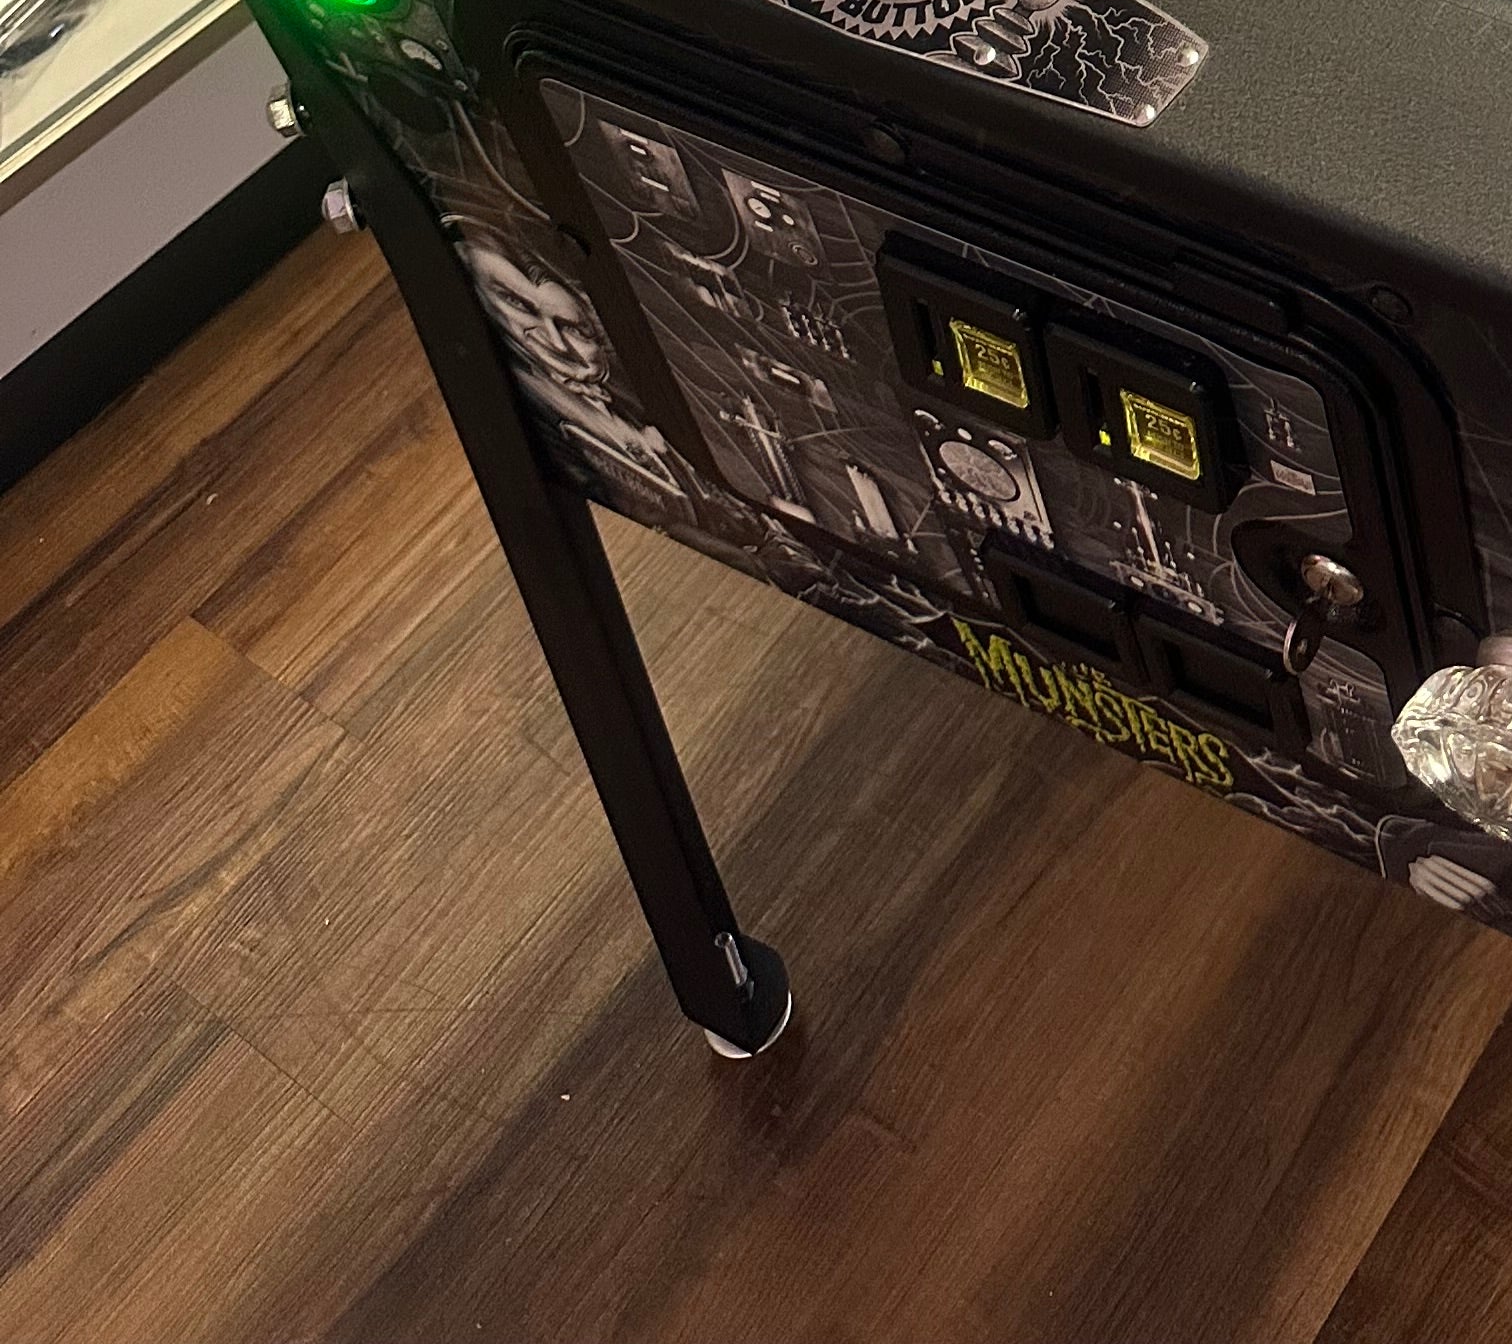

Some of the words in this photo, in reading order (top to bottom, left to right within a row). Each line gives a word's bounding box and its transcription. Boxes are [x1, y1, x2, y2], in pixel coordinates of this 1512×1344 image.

[975, 343, 1011, 370] 25¢
[1147, 413, 1183, 442] 25¢
[952, 618, 1235, 790] MUNSTERS
